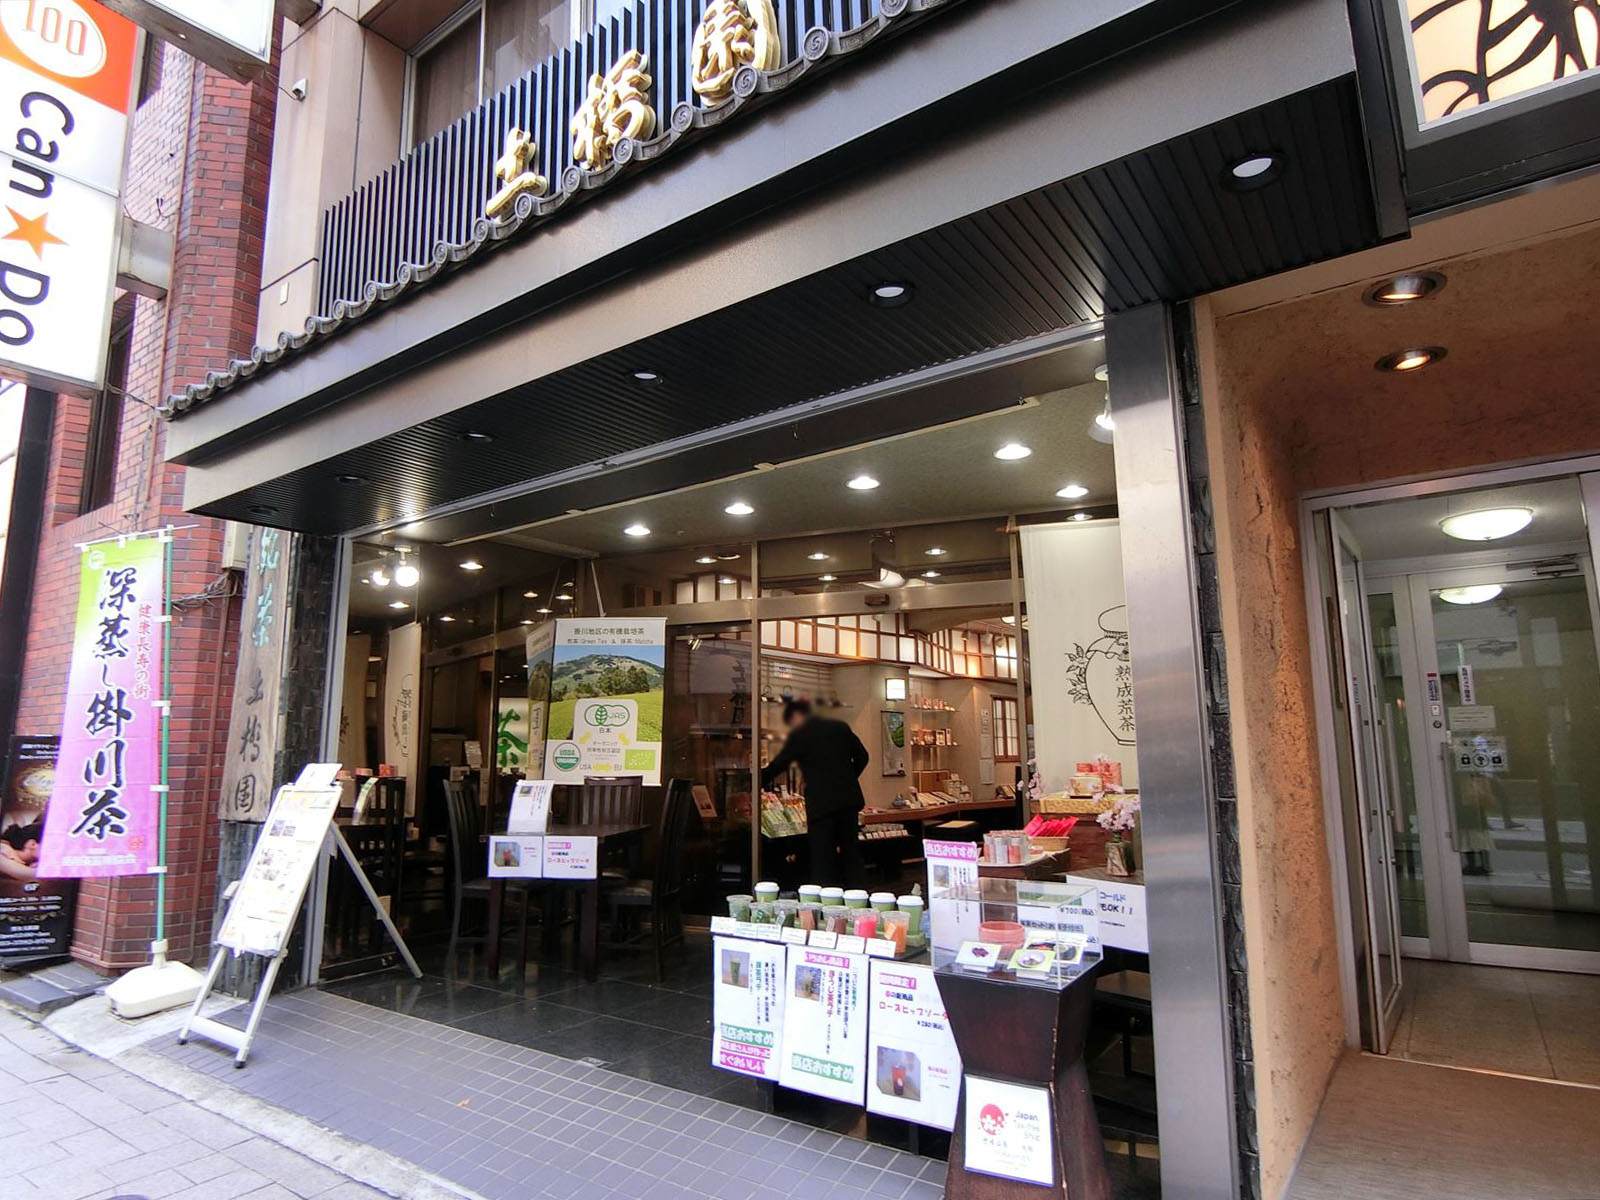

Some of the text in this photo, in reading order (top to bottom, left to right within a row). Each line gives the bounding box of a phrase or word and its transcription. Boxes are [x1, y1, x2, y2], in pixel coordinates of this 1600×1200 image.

[0, 91, 76, 346] Can Do
[73, 568, 138, 841] 深蒸し掛川茶
[1114, 664, 1136, 733] 熟成荒茶
[926, 843, 977, 860] 当店おすすめ
